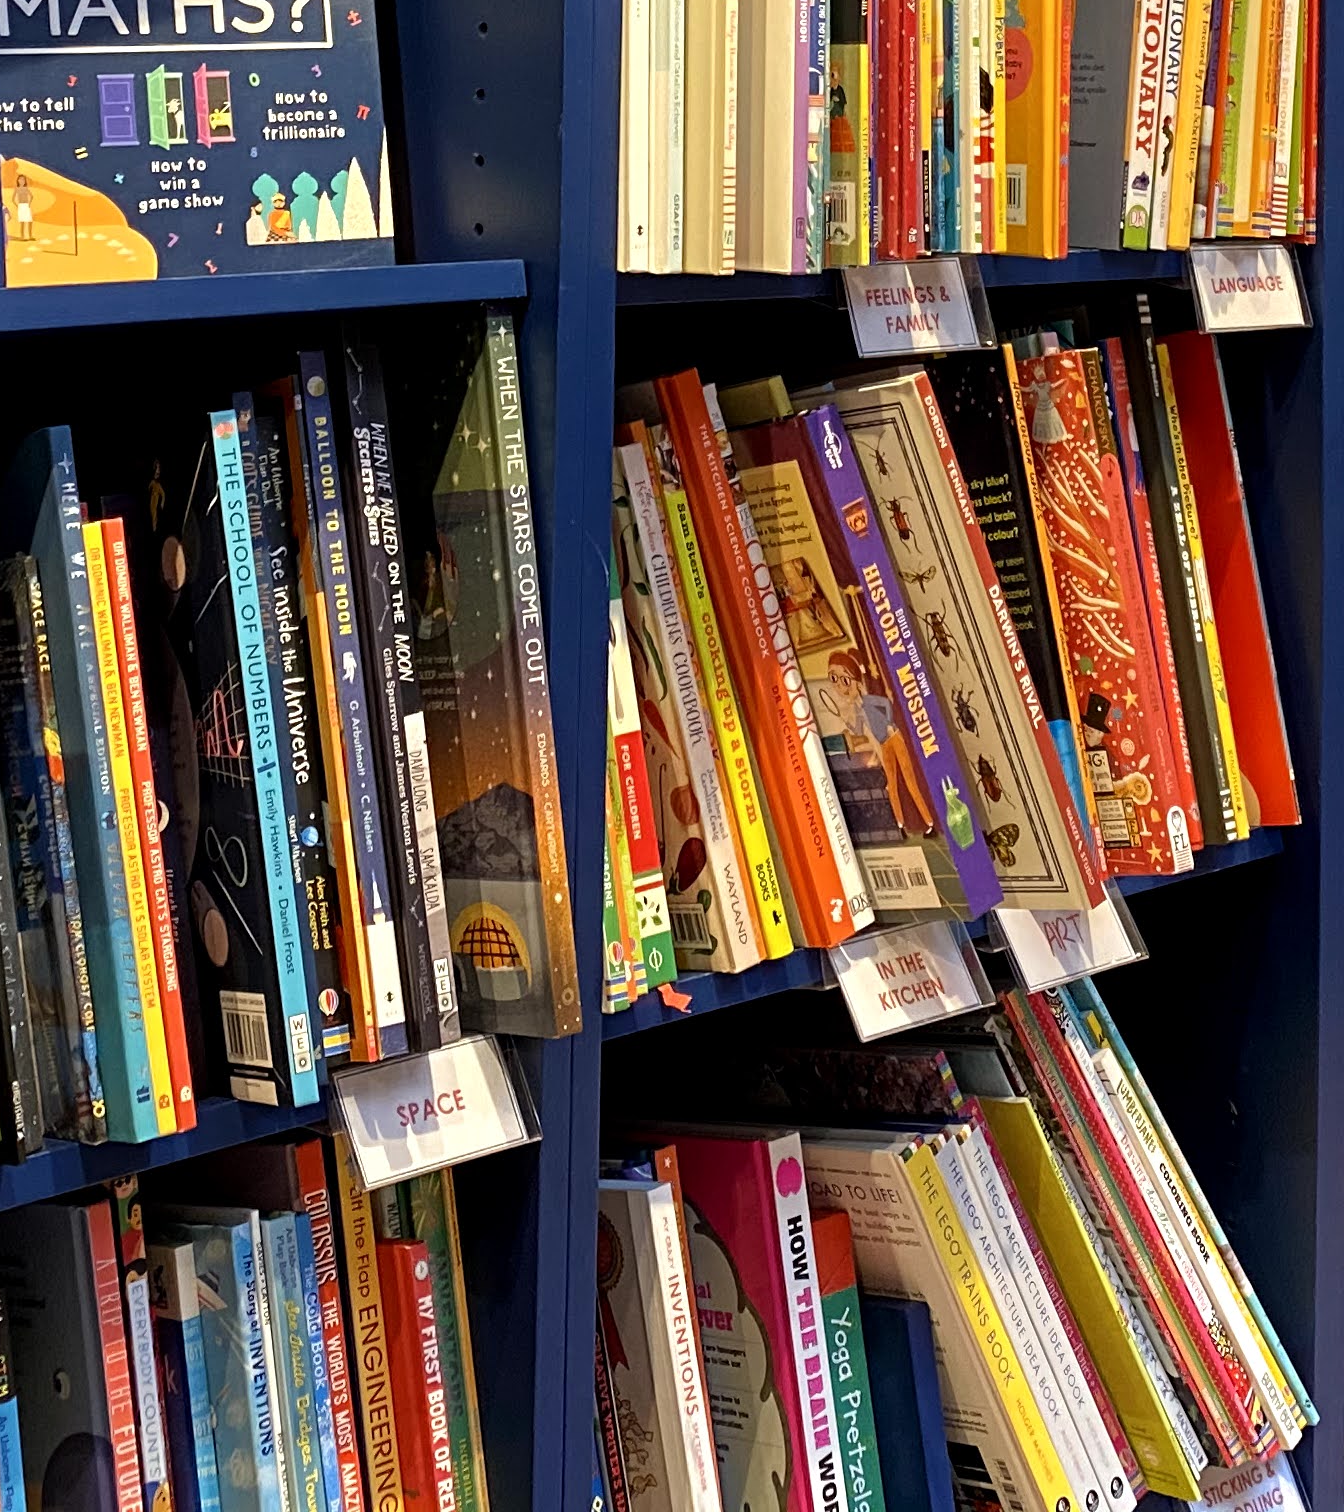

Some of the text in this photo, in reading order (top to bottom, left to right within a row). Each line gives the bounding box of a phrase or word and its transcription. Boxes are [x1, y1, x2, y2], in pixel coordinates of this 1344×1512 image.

[262, 124, 346, 141] trillionaire
[865, 285, 951, 309] FEELINGS &
[1211, 274, 1284, 296] LANGUAGE
[885, 310, 942, 335] FAMILY
[922, 393, 976, 529] DORION TENNANT
[495, 355, 548, 688] WHEN THE STARS COME OUT
[219, 447, 273, 751] THE SCHOOL OF NUMBERS
[860, 561, 942, 762] HISTORY MUSEUM
[987, 583, 1047, 732] DARWIN'S RIVAL
[620, 744, 644, 843] FOR CHILDREN
[1041, 913, 1085, 957] ART
[875, 951, 926, 981] IN THE
[878, 977, 945, 1012] KITCHEN
[396, 1088, 466, 1128] SPACE
[918, 1165, 939, 1207] THE
[957, 1261, 992, 1329] TRAINS
[983, 1331, 1018, 1390] BOOK
[666, 1274, 700, 1417] INVENTIONS
[1203, 1463, 1275, 1508] STICKING &
